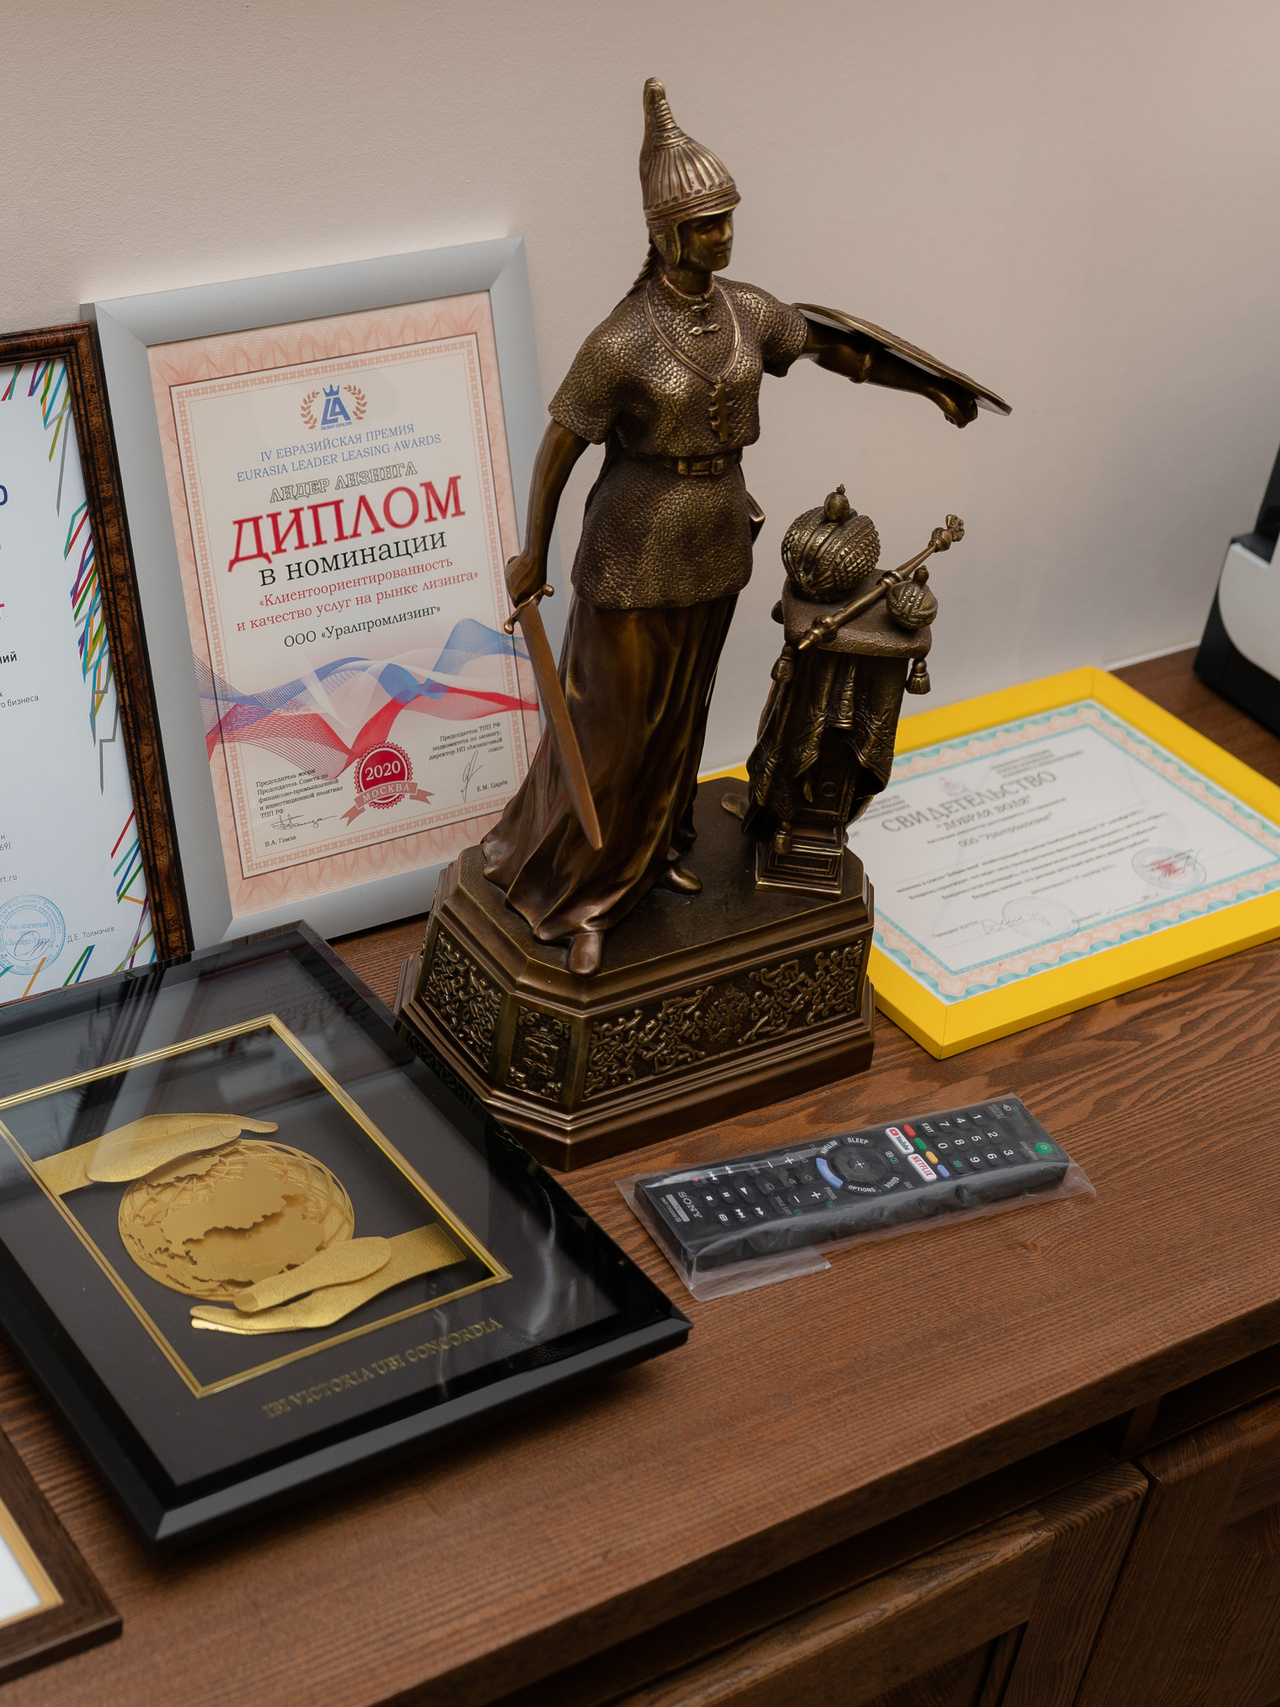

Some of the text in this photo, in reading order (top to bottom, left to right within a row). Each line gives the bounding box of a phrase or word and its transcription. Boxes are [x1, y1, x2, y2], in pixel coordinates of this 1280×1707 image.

[236, 433, 441, 482] EURASIA LEADER LEASING AWARDS
[260, 450, 271, 461] IV
[276, 433, 361, 458] ЕВРАЗИЙСКАЯ
[365, 423, 414, 441] ПРЕМИЯ
[269, 461, 417, 503] ЛИДЕР ЛИЗИНГА
[227, 475, 465, 572] ДИПЛОМ
[258, 531, 446, 586] в номинации
[259, 558, 452, 606] «Клиентоориентированность
[236, 572, 477, 631] и качество услуг на рынке лизинга»
[283, 606, 440, 647] ООО «Уралпромлизинг»
[5, 695, 39, 707] бизнеса
[364, 760, 401, 782] 2020
[362, 783, 410, 803] МОСКВА
[847, 1137, 869, 1145] SLEEP
[921, 1122, 935, 1134] EXIT
[911, 1155, 934, 1177] NETFLIX
[678, 1191, 703, 1219] SONY
[848, 1184, 876, 1193] OPTIONS
[287, 1368, 375, 1408] VICTORIA
[371, 1354, 406, 1376] UBI
[405, 1317, 504, 1363] CONCORDIA
